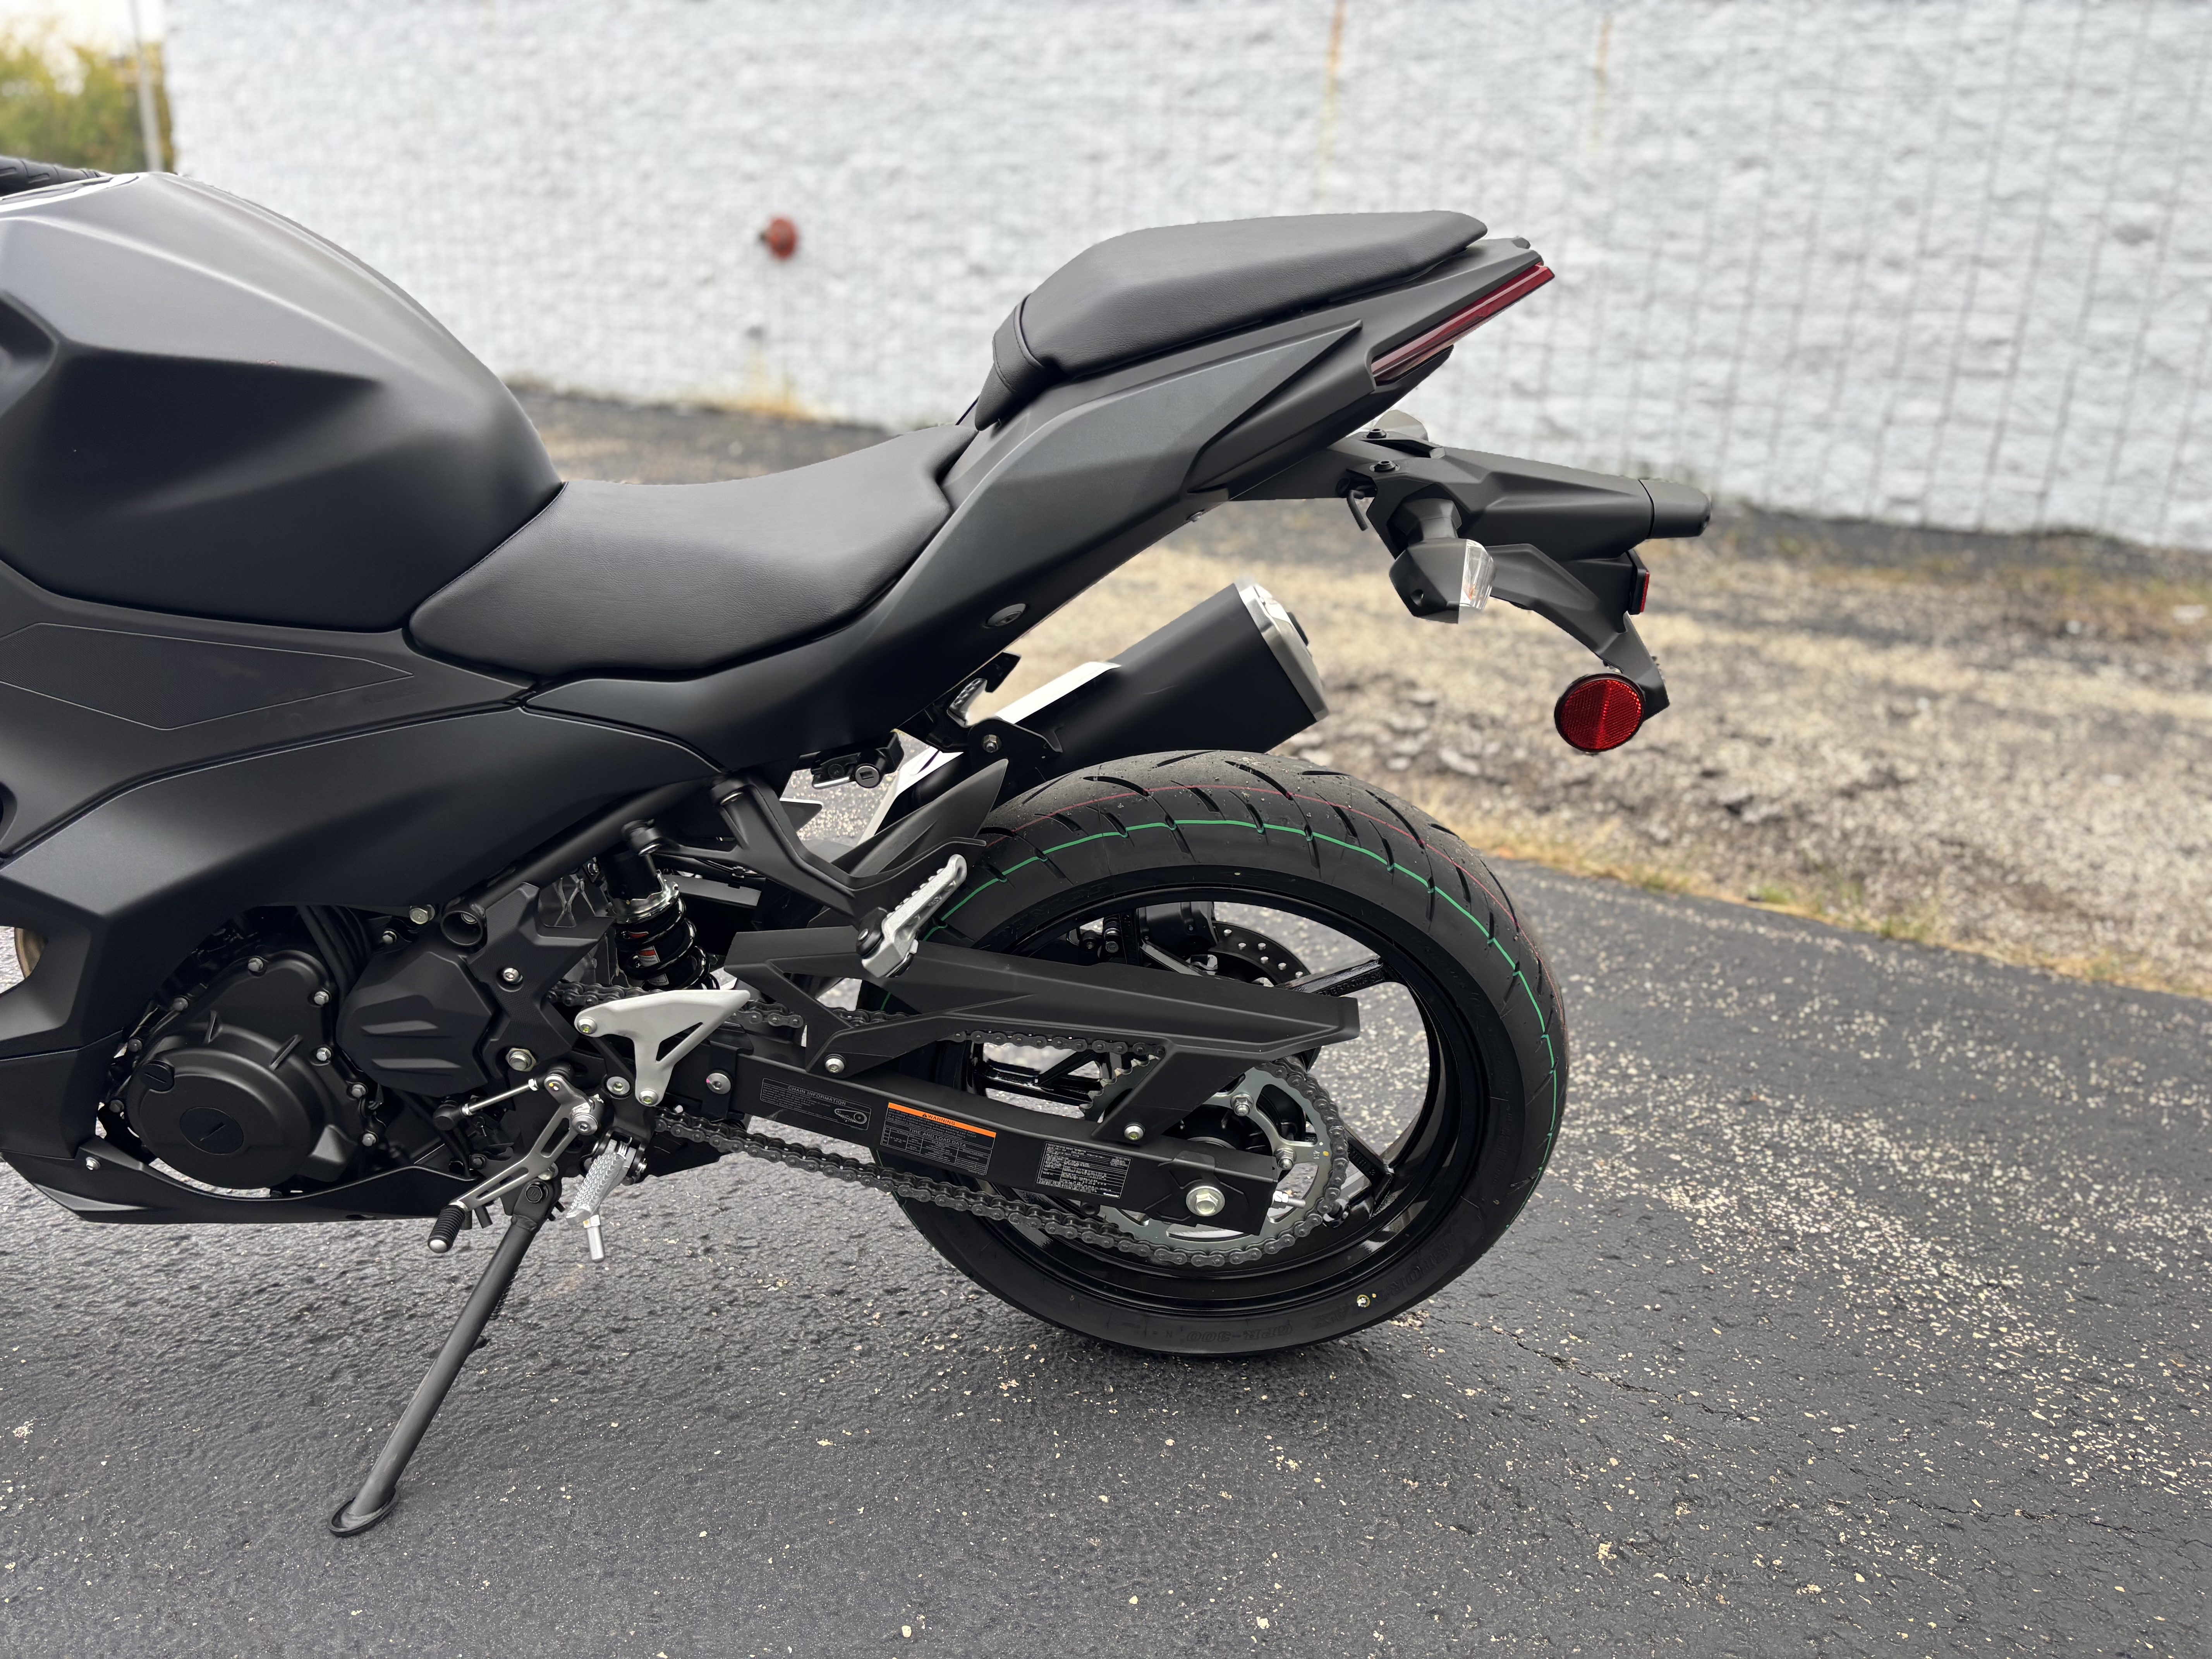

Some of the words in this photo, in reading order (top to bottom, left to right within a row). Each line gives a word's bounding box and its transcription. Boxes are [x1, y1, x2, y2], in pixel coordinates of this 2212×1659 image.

[788, 1085, 805, 1094] CHAIN
[807, 1091, 846, 1106] INFORMATION
[928, 1115, 955, 1125] WARNING
[1187, 1323, 1293, 1342] GPR-300
